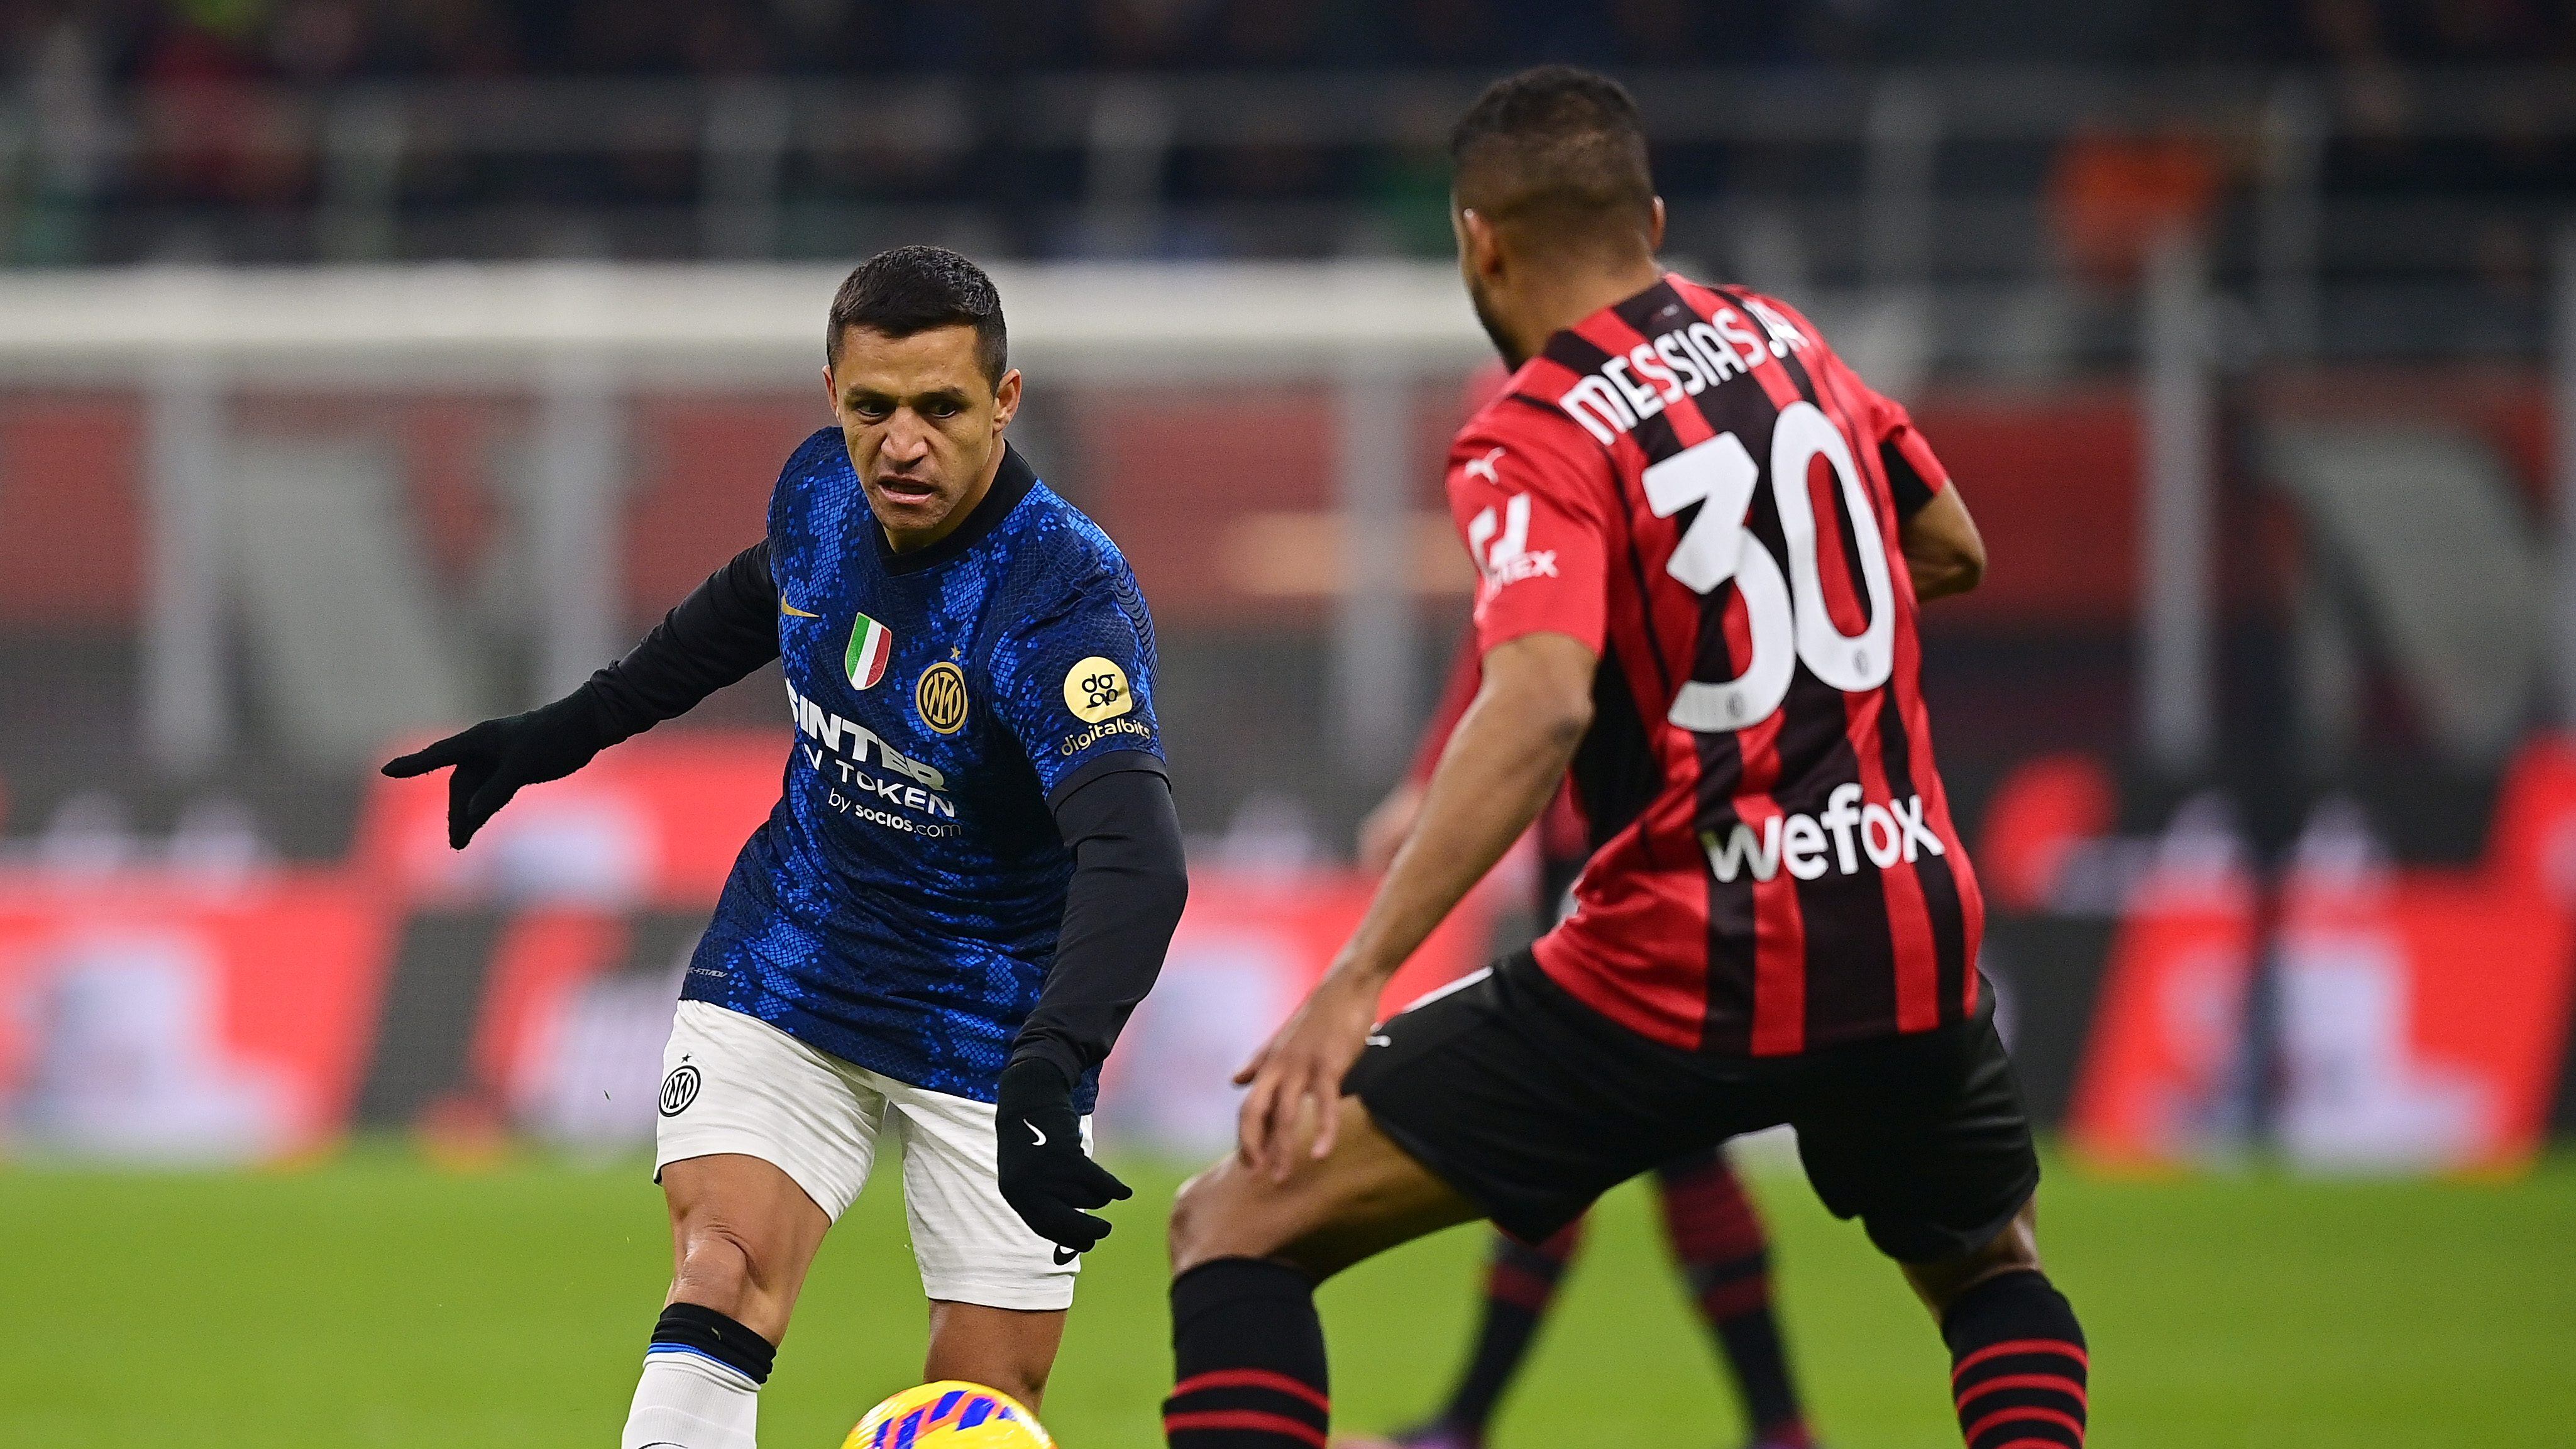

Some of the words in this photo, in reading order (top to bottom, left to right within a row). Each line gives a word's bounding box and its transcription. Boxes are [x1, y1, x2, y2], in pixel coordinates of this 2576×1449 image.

[1559, 308, 1767, 446] MESSIAS
[1641, 400, 1895, 732] 30
[1061, 718, 1150, 756] digitalbits
[828, 788, 851, 813] by
[856, 804, 962, 837] socios.com
[835, 759, 955, 818] TOKEN
[1700, 782, 1946, 883] wefox
